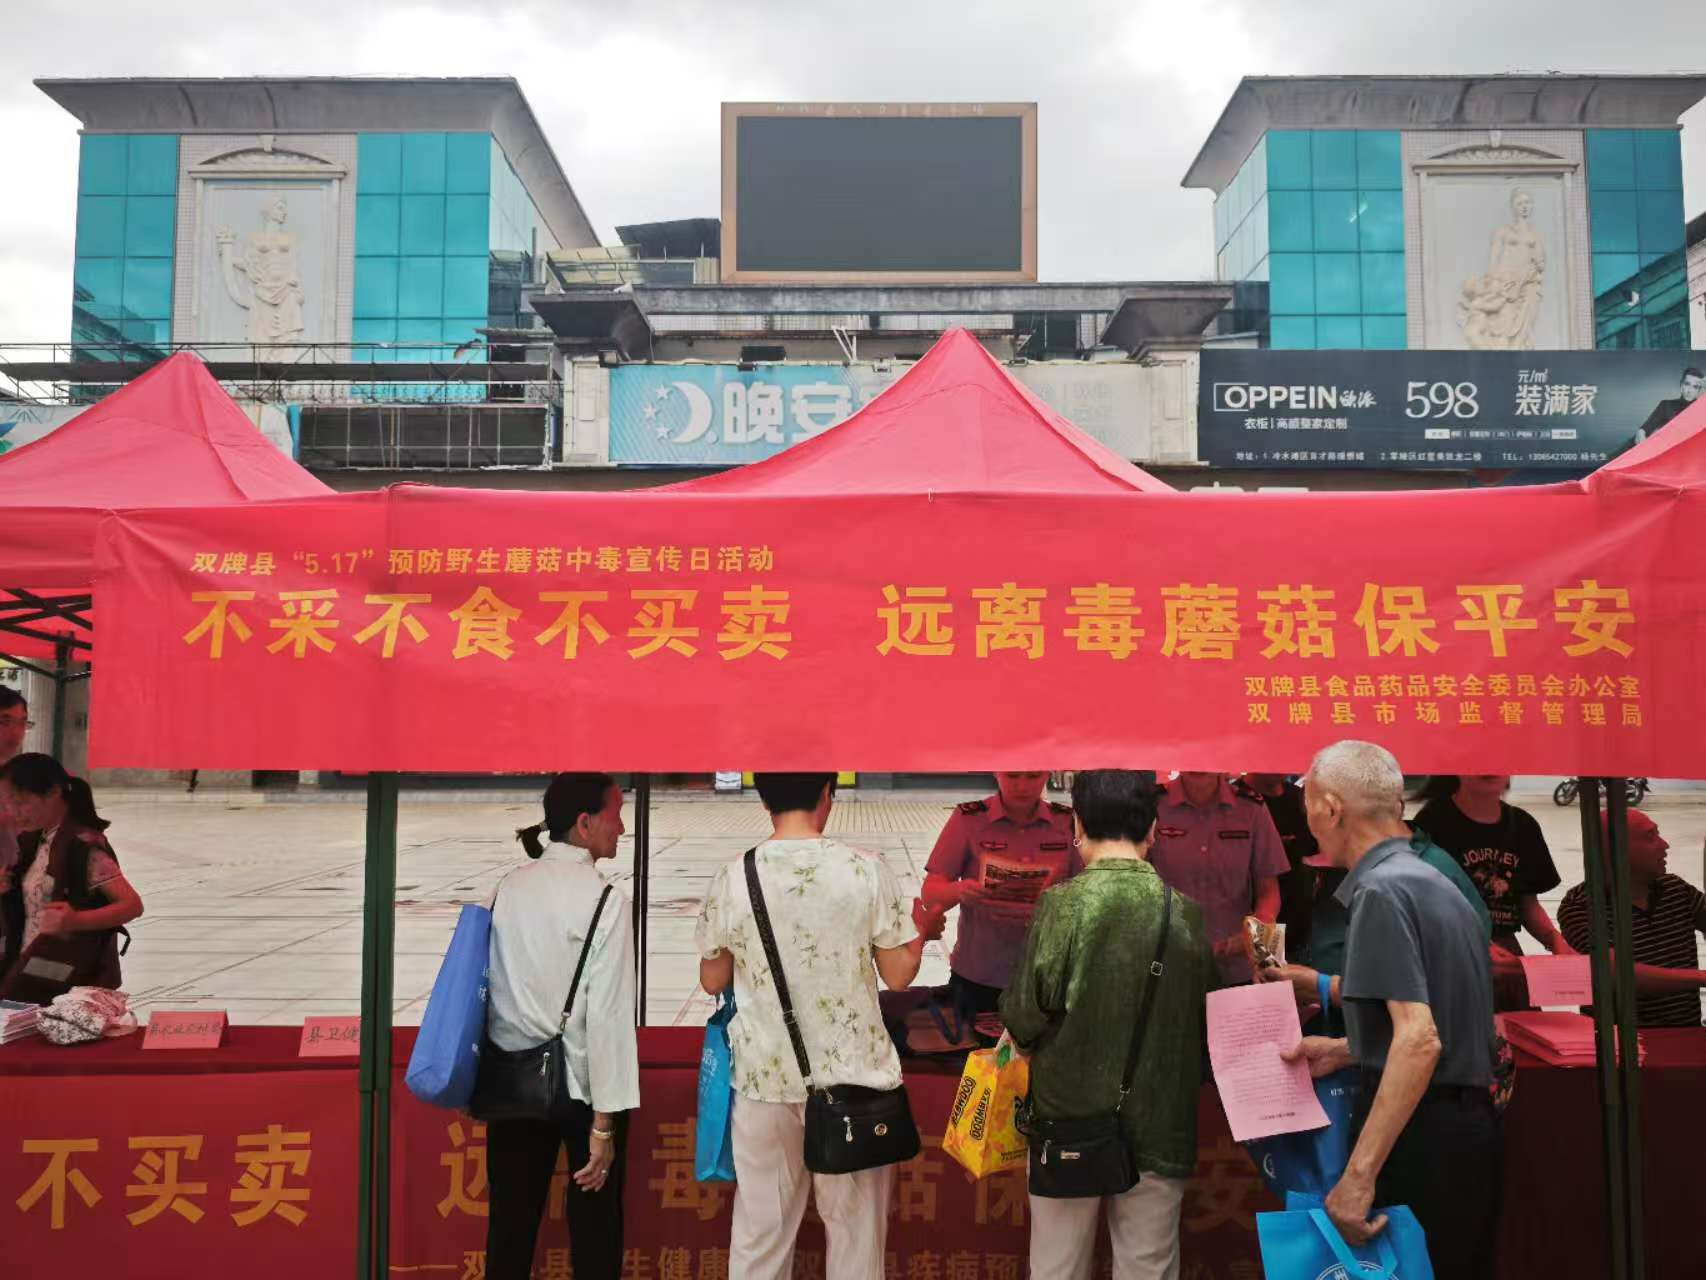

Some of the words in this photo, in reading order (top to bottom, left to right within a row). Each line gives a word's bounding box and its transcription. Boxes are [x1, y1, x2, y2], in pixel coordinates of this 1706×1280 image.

[723, 381, 877, 444] 晚安
[1224, 386, 1337, 409] OPPEIN
[1405, 382, 1479, 418] 598
[1515, 384, 1598, 415] 装满家
[191, 552, 277, 576] 双牌县
[388, 545, 775, 575] 预防野生蘑菇中毒宣传日活动
[183, 584, 793, 661] 不采不食不买卖
[876, 579, 1635, 660] 远离毒蘑菇保平安
[1245, 674, 1640, 698] 双牌县食品药品安全委员会办公室
[1248, 701, 1643, 727] 双牌县市场监督管理局
[16, 1125, 312, 1229] 不买卖
